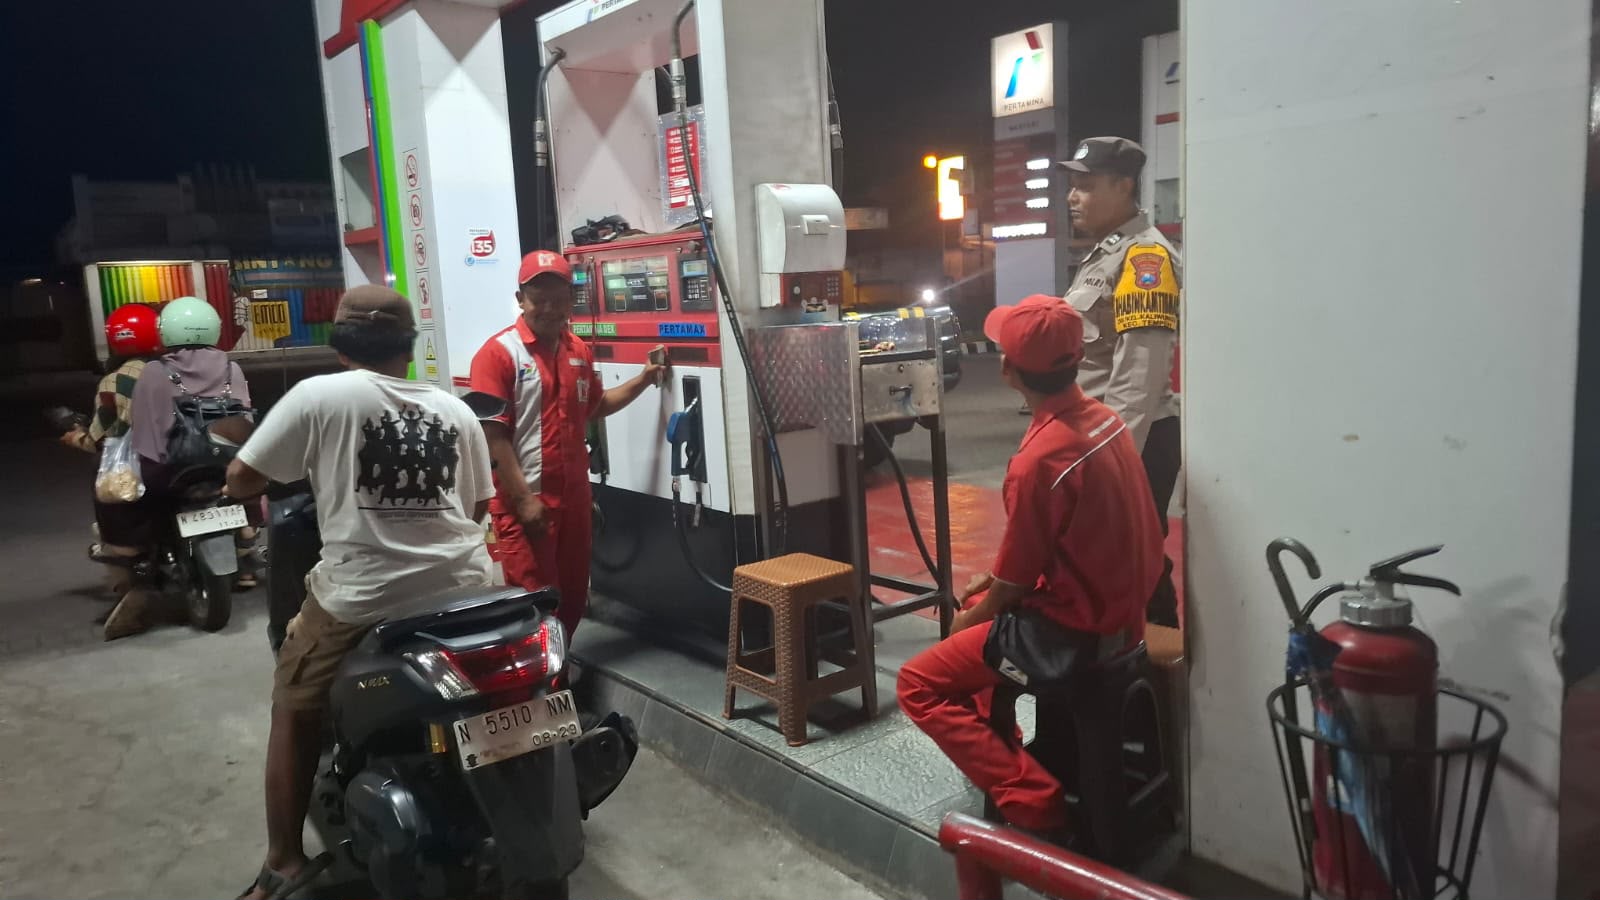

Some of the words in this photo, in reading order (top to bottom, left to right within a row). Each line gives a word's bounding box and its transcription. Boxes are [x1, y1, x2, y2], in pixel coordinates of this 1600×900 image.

[1004, 97, 1044, 112] PERTAMINA
[471, 240, 493, 253] 135
[253, 303, 286, 325] EMCO
[658, 323, 706, 335] PERTAMAX
[458, 723, 471, 743] N
[485, 706, 532, 735] 5510
[546, 694, 573, 717] NM
